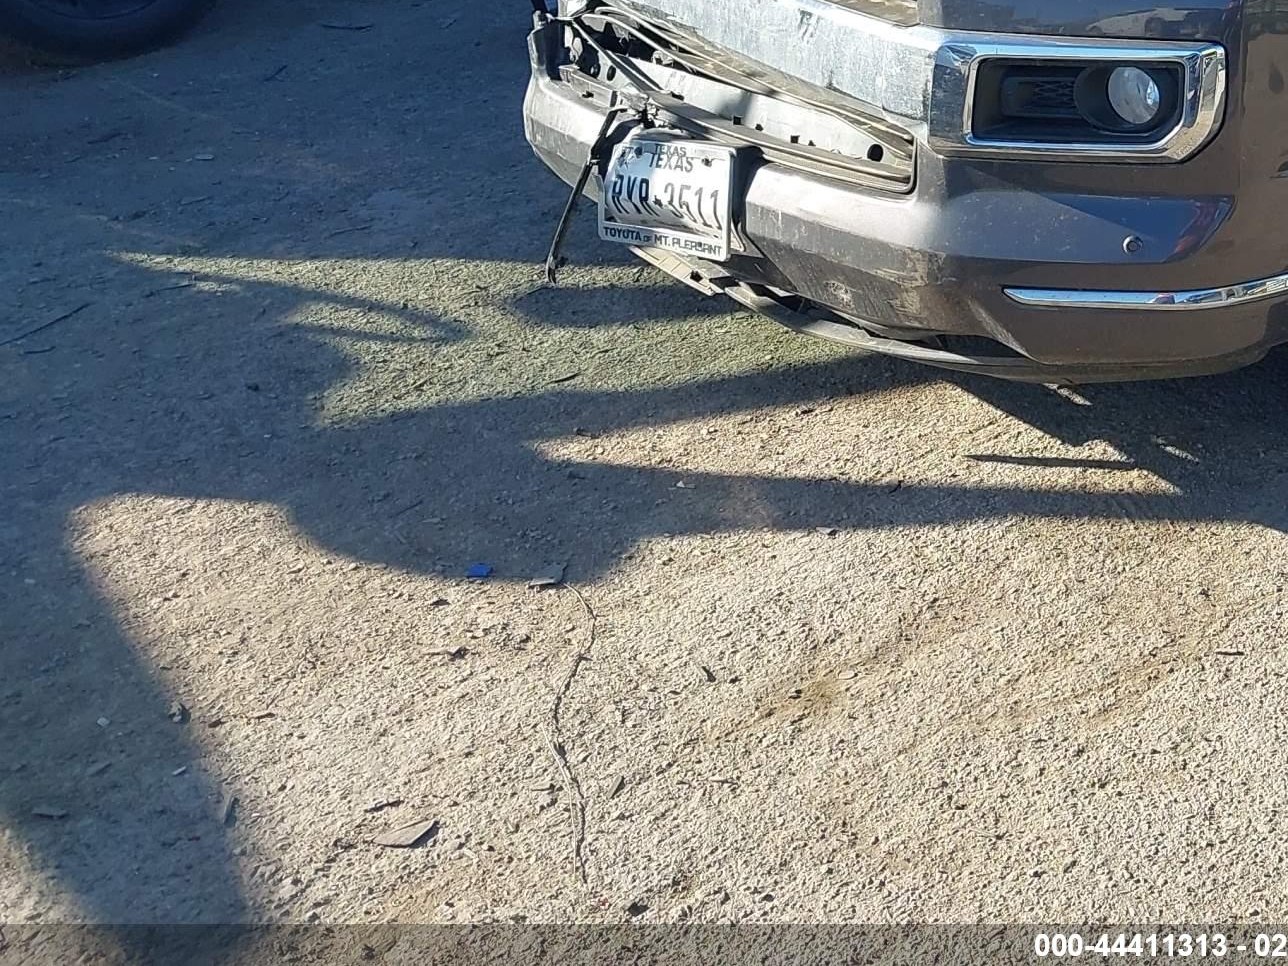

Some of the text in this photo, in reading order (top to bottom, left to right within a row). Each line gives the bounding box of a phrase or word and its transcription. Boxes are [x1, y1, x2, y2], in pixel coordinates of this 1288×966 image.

[655, 144, 687, 157] TEXAS
[649, 153, 694, 173] TEXAS
[603, 226, 641, 242] TOYOTA
[655, 234, 671, 247] MT.
